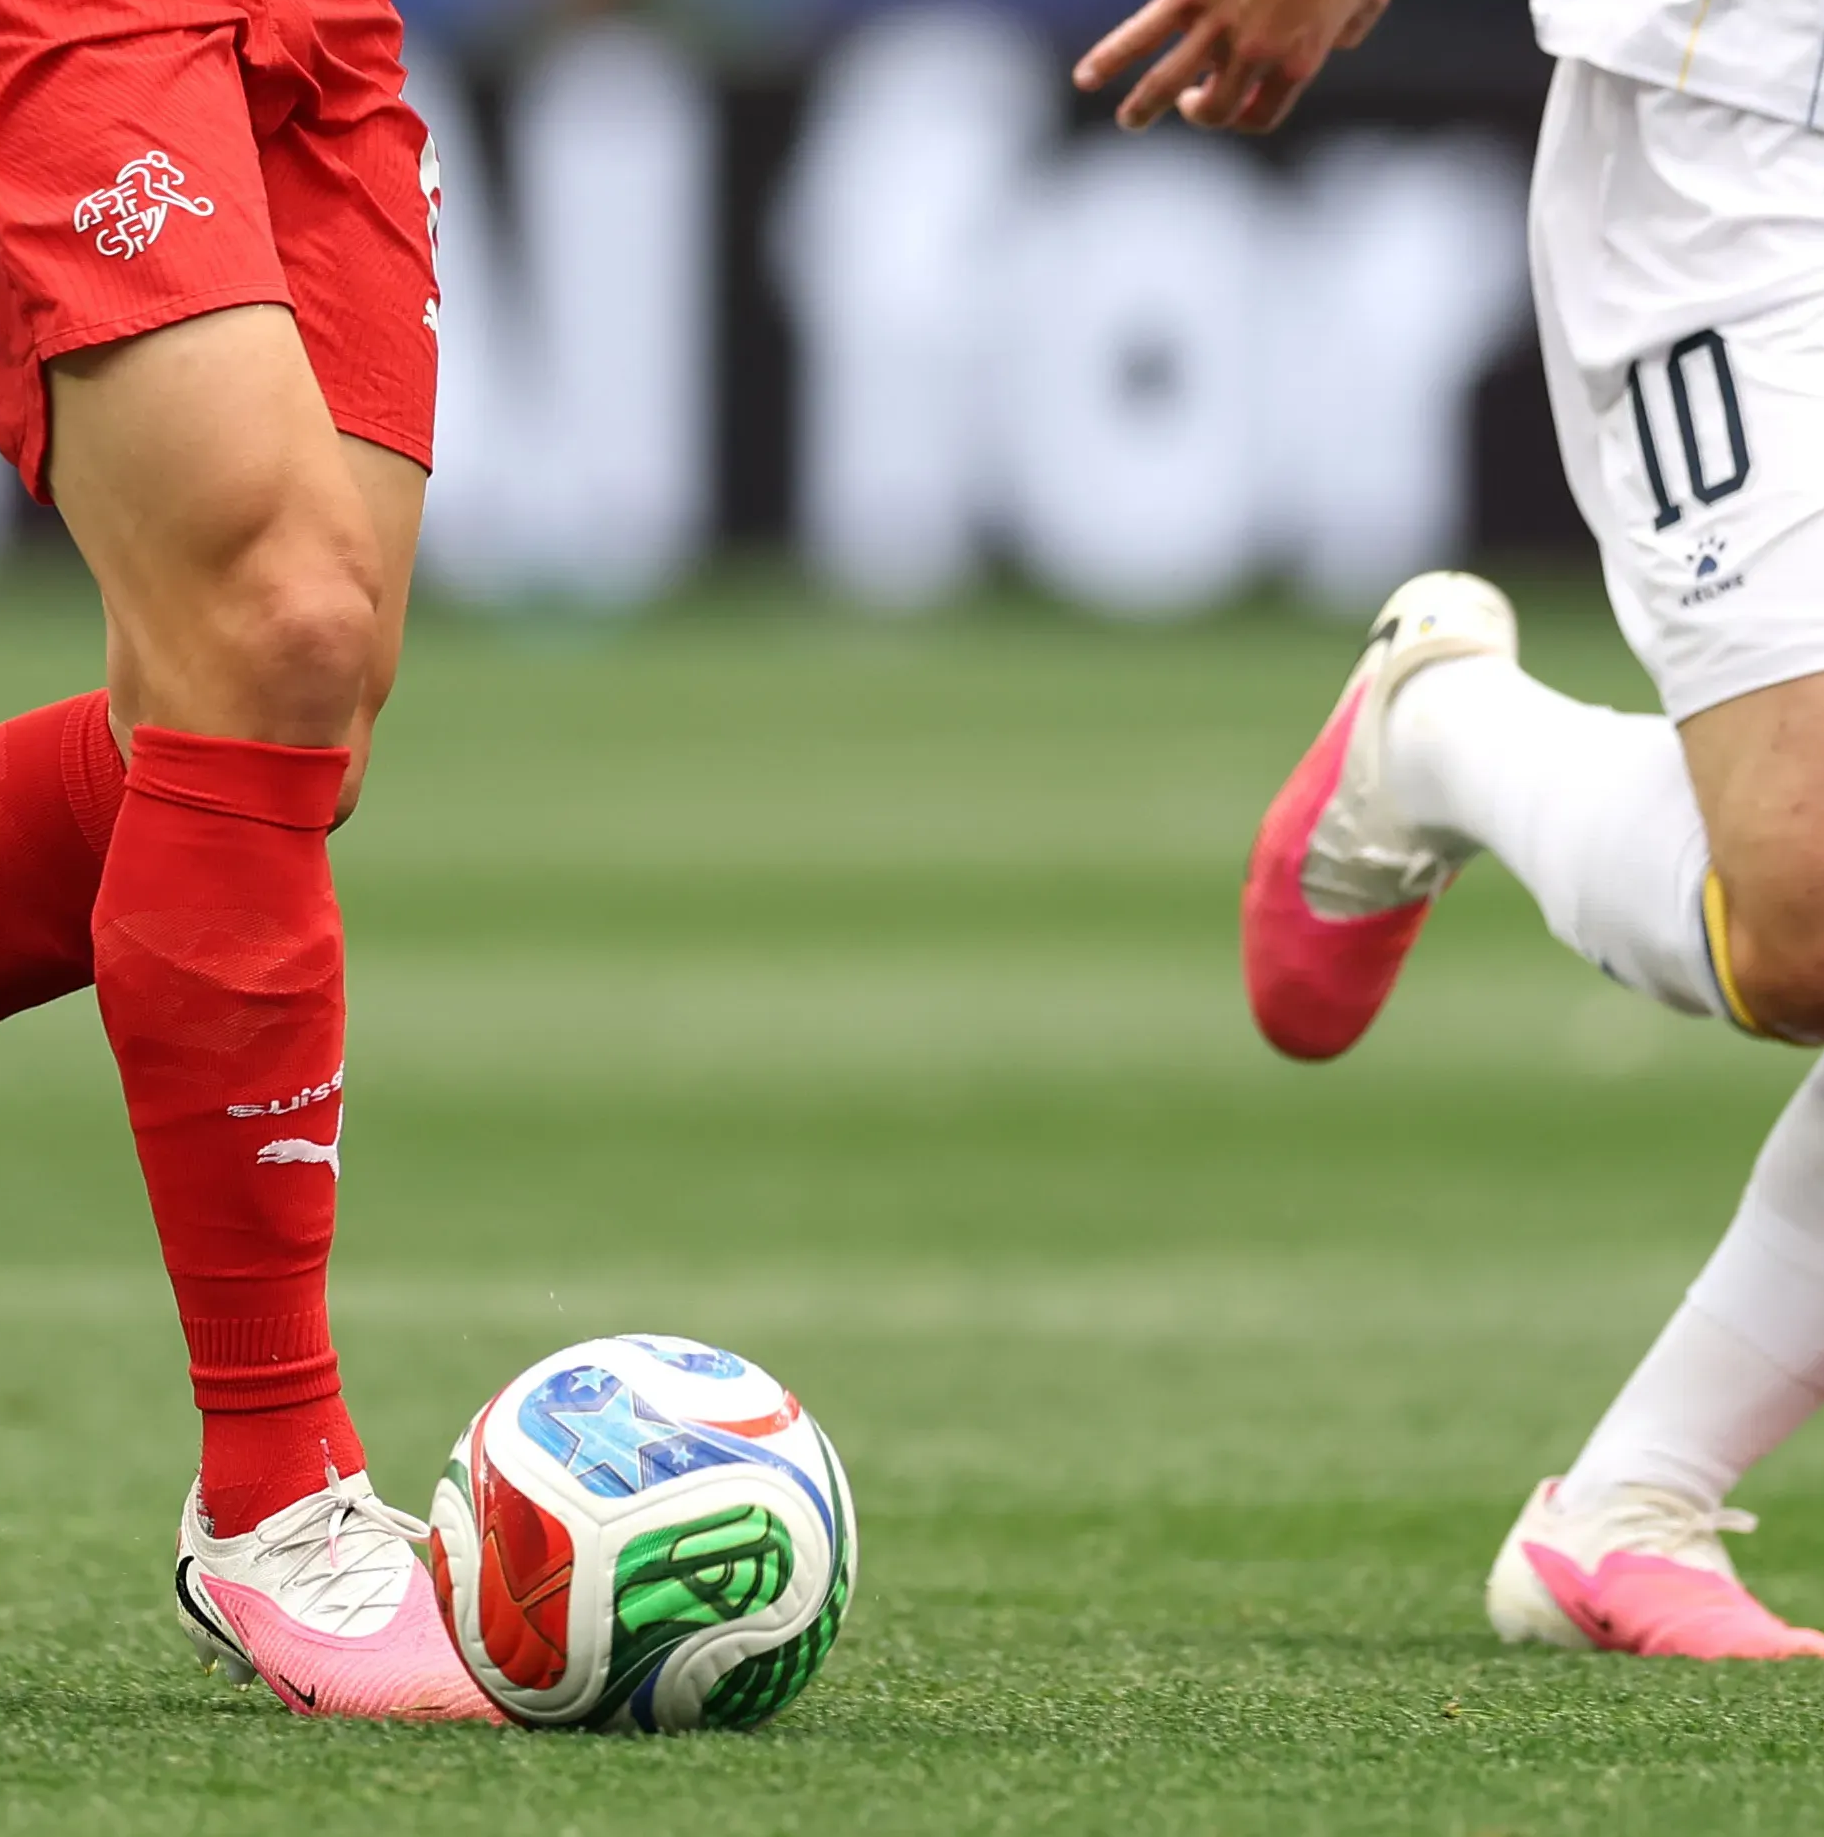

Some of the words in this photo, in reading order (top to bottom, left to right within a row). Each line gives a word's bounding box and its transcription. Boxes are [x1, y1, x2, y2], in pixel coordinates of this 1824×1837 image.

[767, 2, 1527, 619] for
[1626, 328, 1751, 532] 10
[226, 1059, 345, 1118] suiss
